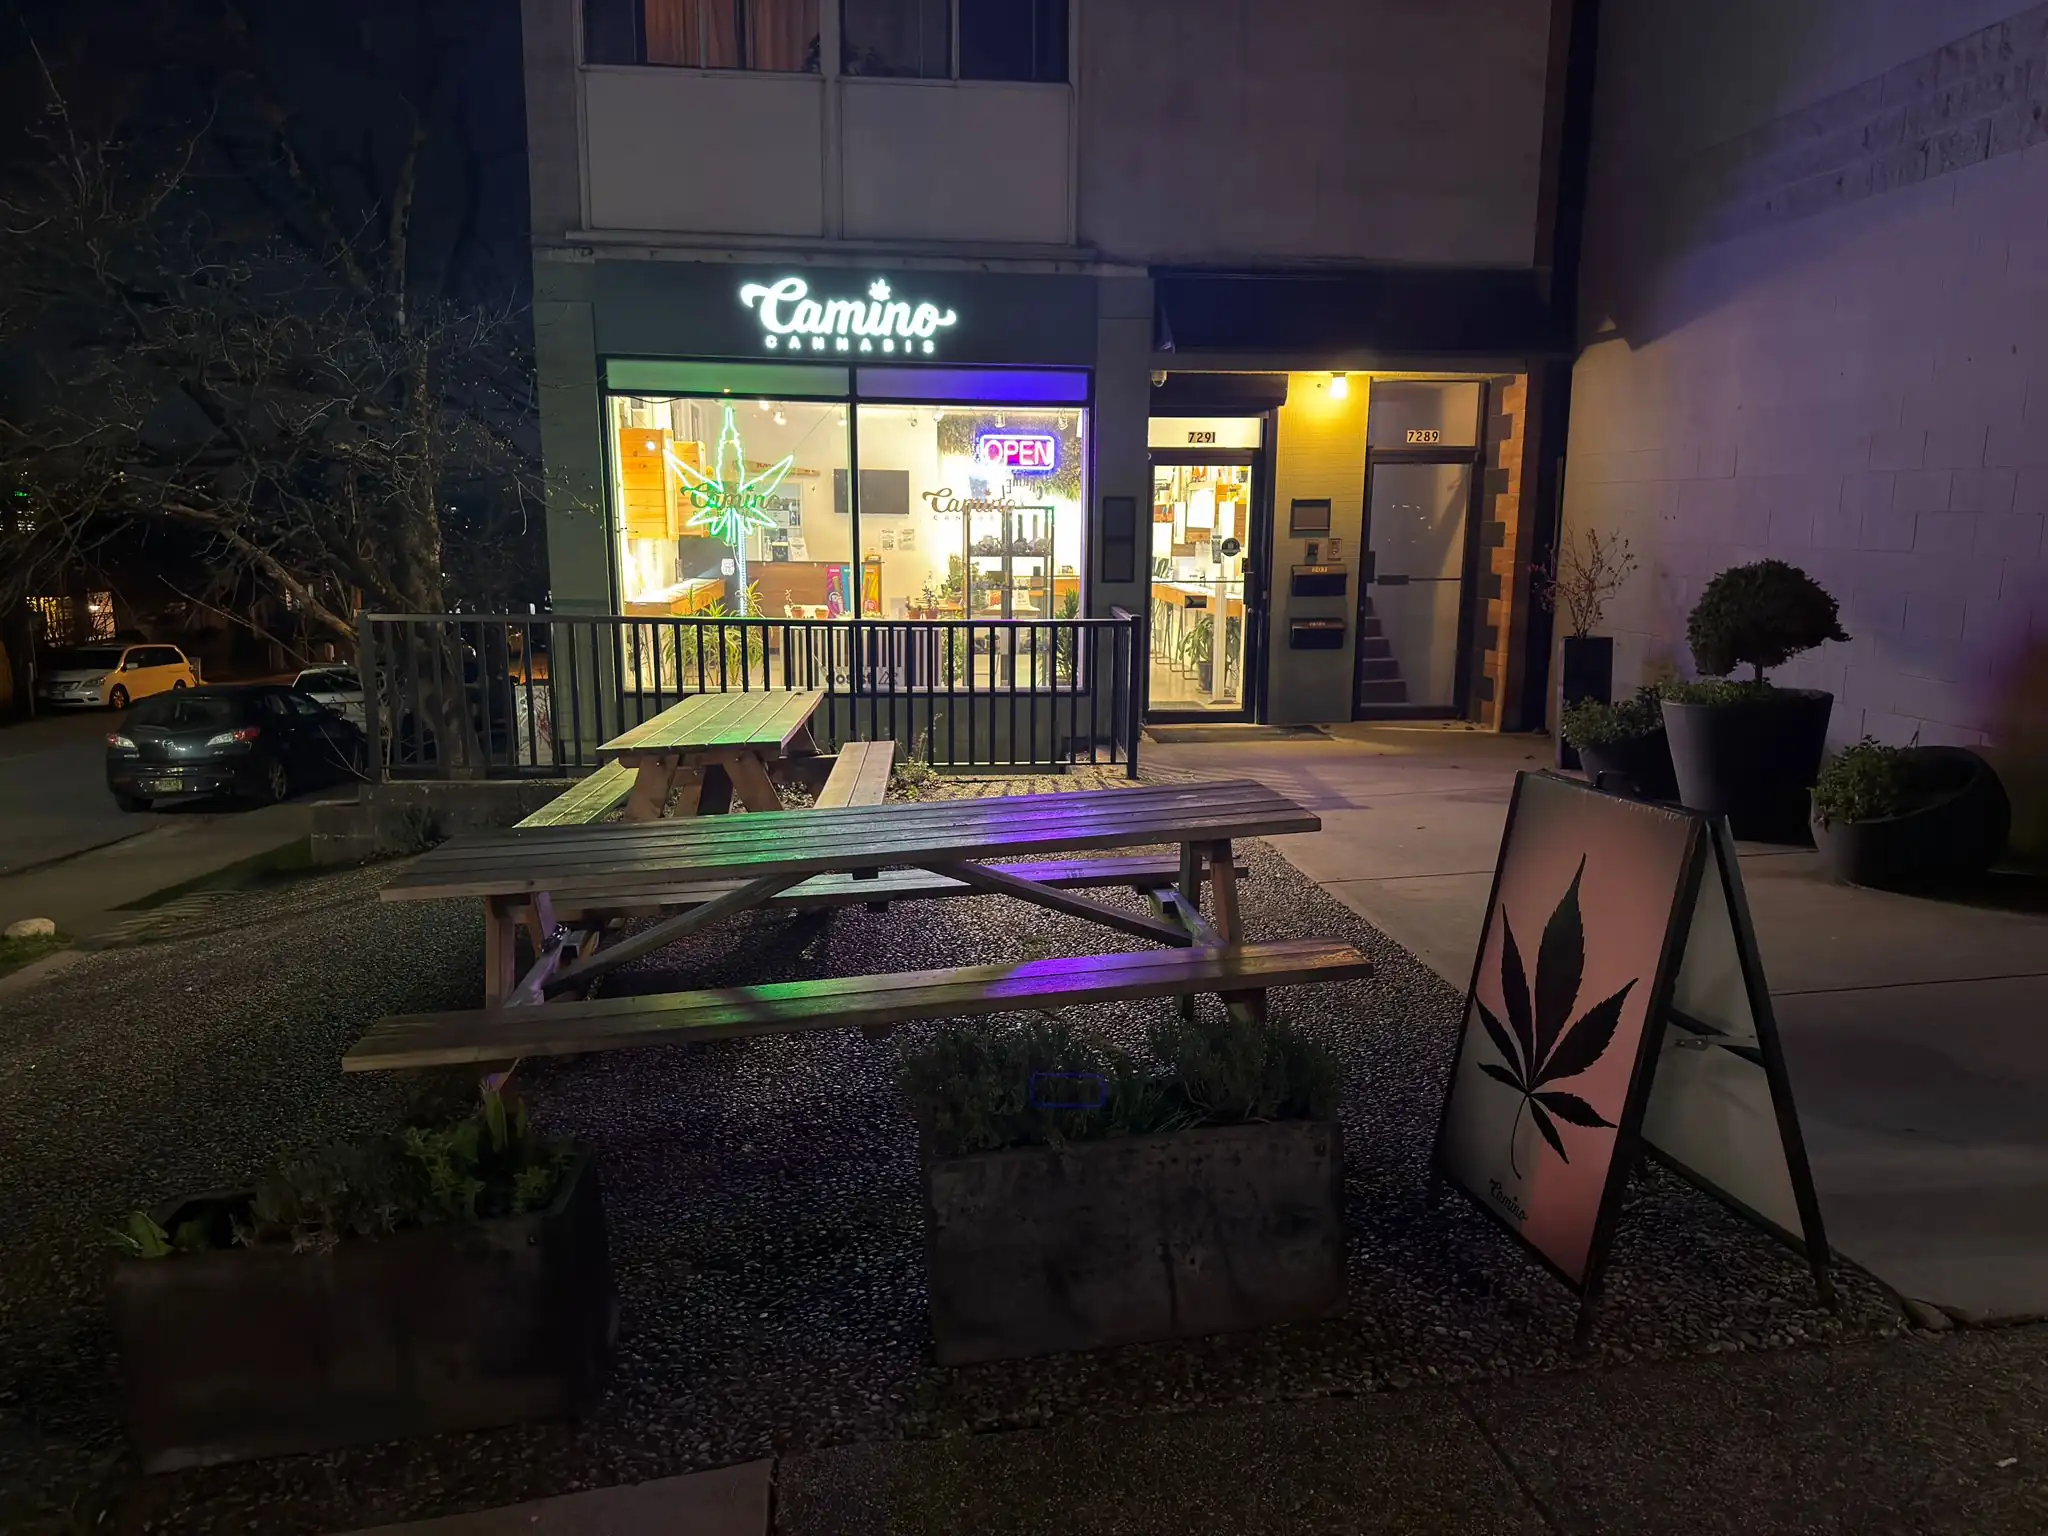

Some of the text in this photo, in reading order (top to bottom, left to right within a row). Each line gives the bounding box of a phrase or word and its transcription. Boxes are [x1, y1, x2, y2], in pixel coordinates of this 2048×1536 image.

[740, 277, 957, 337] Camino
[765, 335, 934, 353] CANNABIS
[1188, 431, 1215, 443] 7291
[1408, 431, 1438, 442] 7289
[985, 440, 1053, 466] OPEN
[922, 487, 1021, 513] Camino
[1489, 1178, 1528, 1221] Camino
